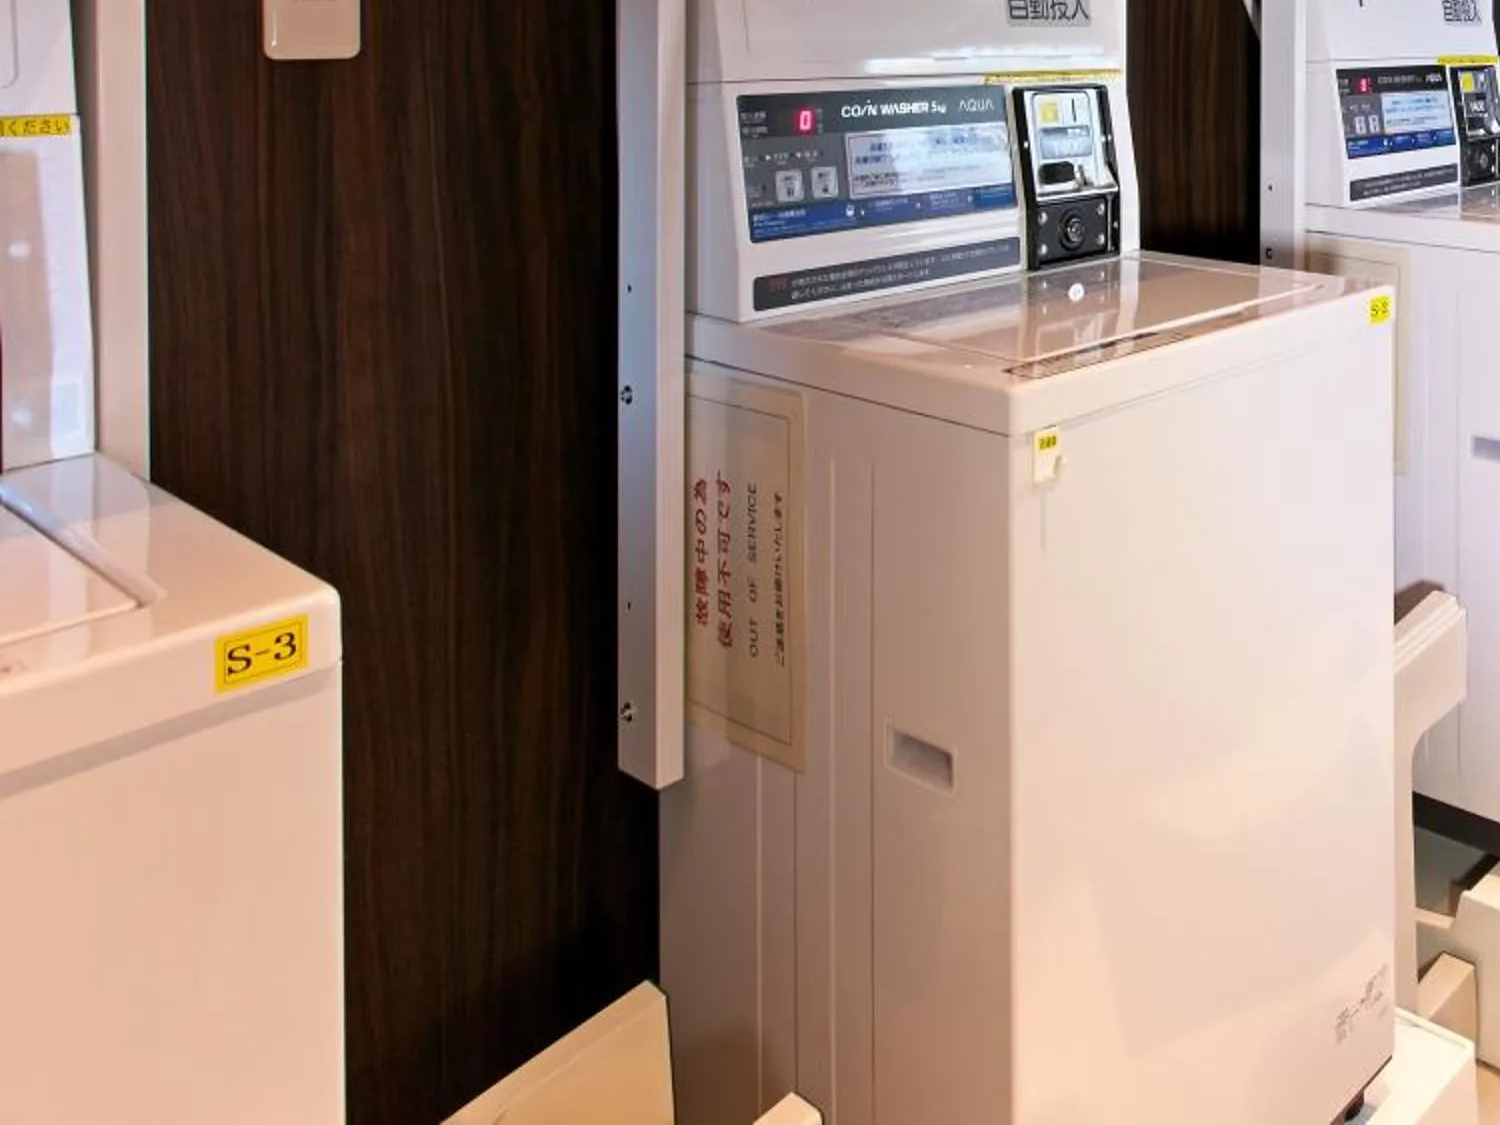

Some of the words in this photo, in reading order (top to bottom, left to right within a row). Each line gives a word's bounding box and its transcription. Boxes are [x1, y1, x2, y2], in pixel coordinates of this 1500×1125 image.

[799, 110, 812, 131] 0
[880, 102, 929, 116] WASHER
[957, 98, 996, 112] AQUA
[0, 119, 70, 136] ください
[747, 482, 757, 565] SERVICE
[717, 469, 734, 650] 使用不可です
[747, 574, 759, 604] OF
[227, 630, 297, 677] S-3
[748, 614, 760, 659] OUT
